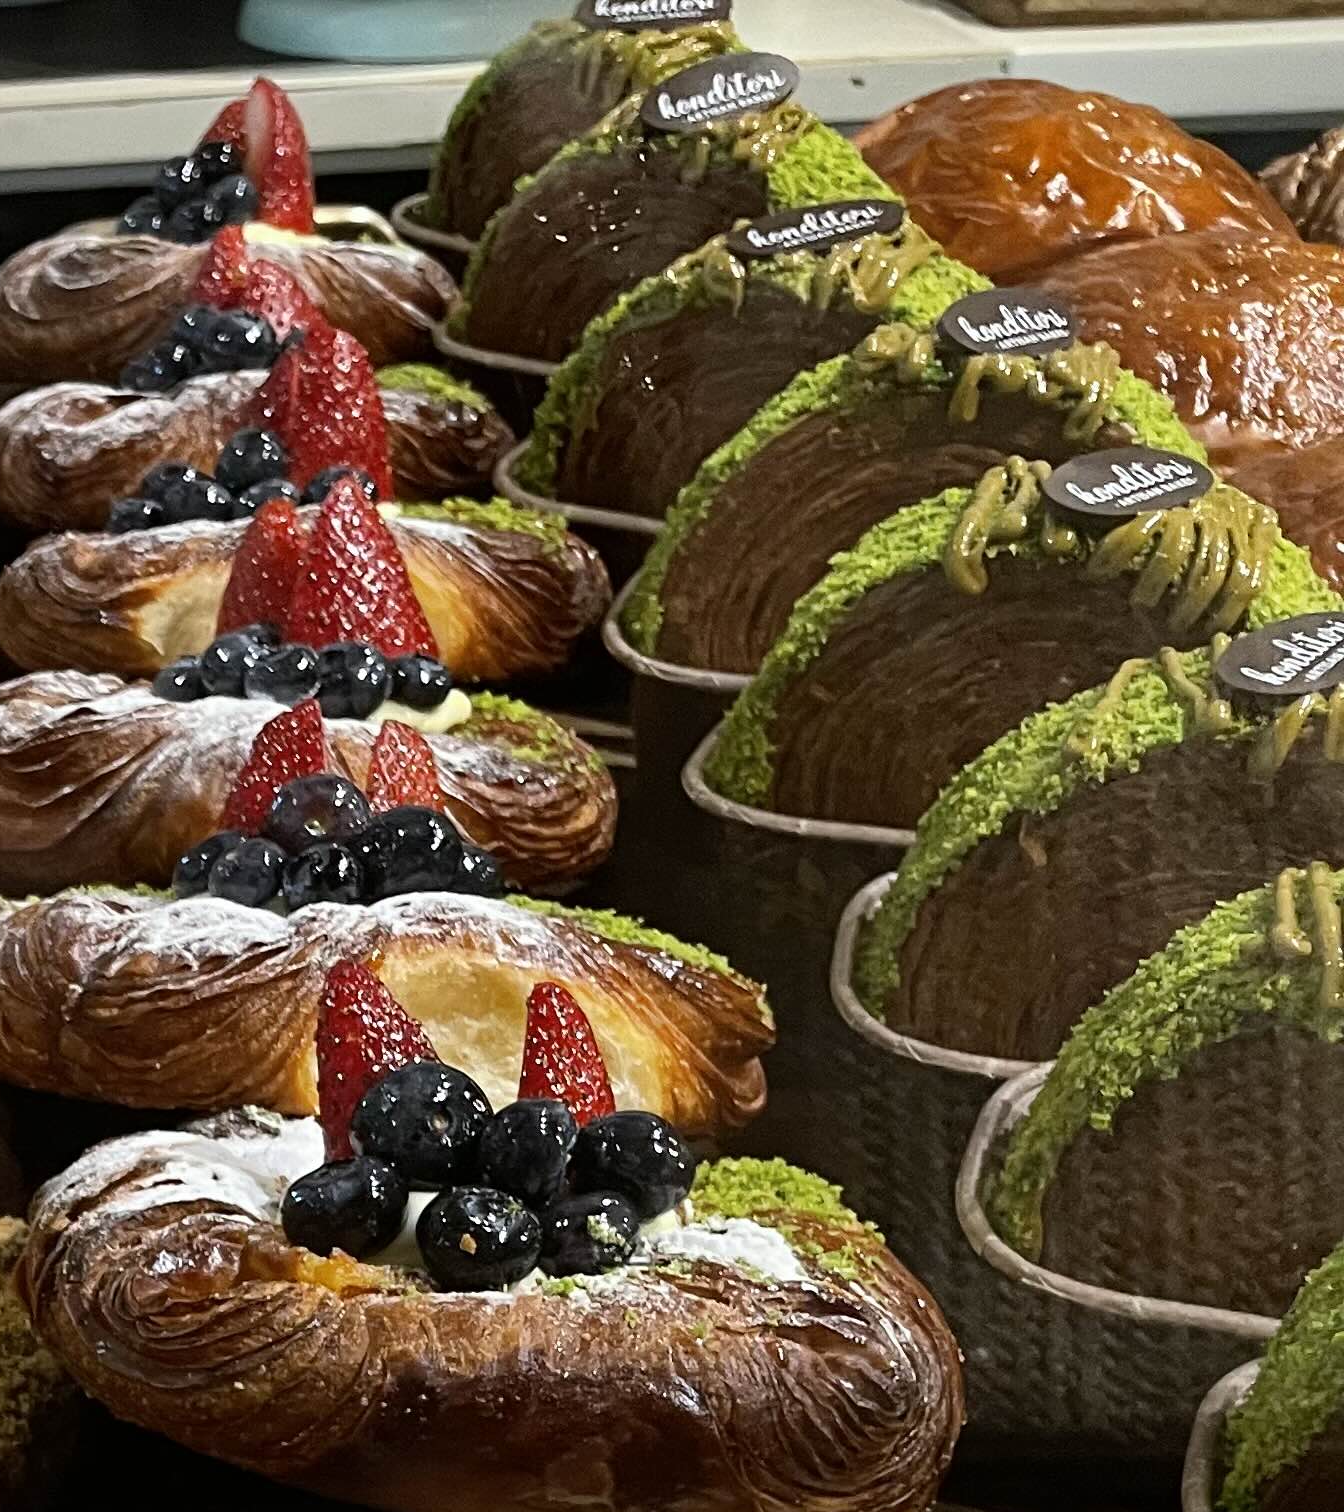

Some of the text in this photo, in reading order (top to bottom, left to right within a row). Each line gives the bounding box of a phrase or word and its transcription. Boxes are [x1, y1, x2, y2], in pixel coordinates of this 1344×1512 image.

[658, 69, 786, 120] konditori
[747, 205, 884, 247] konditori
[957, 304, 1069, 343] konditori
[1066, 459, 1193, 505] konditori
